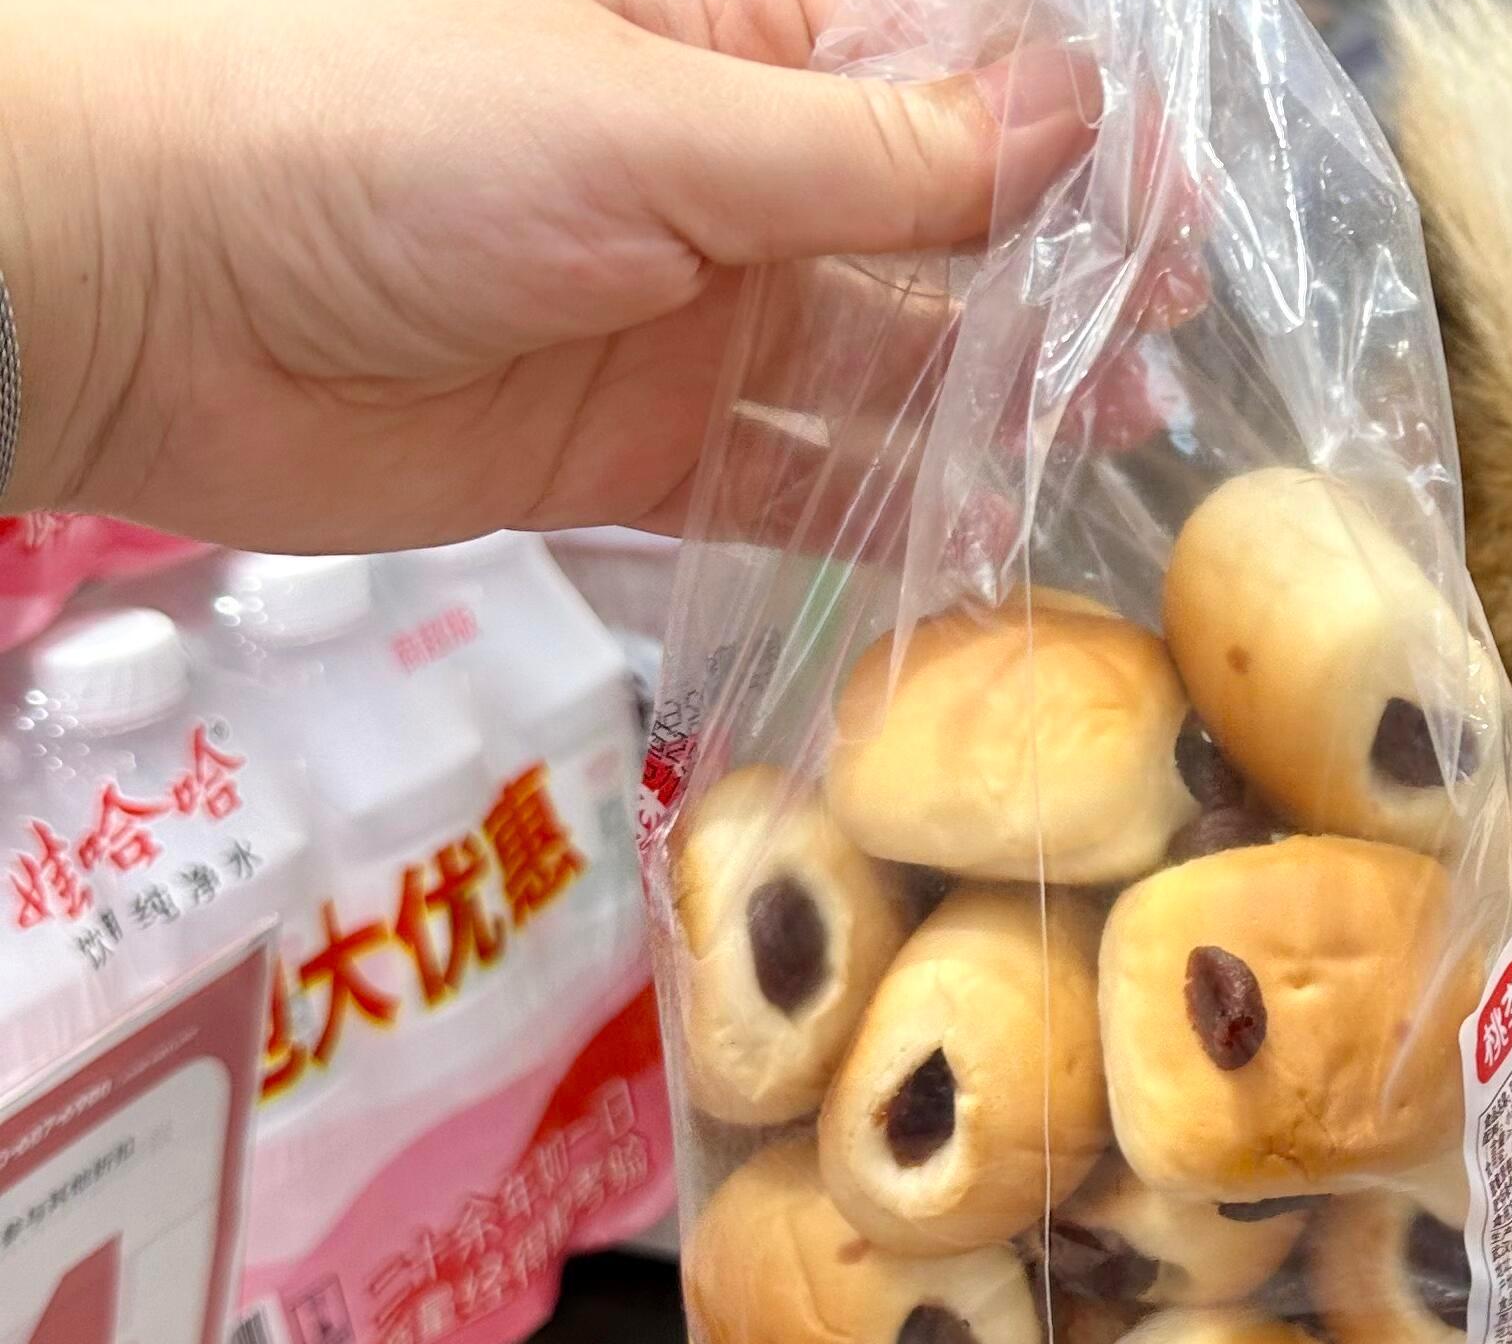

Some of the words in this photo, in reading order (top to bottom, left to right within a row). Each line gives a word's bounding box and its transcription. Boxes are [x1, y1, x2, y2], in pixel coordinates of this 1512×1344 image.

[10, 724, 247, 928] 娃哈哈
[258, 761, 588, 1104] 大优惠
